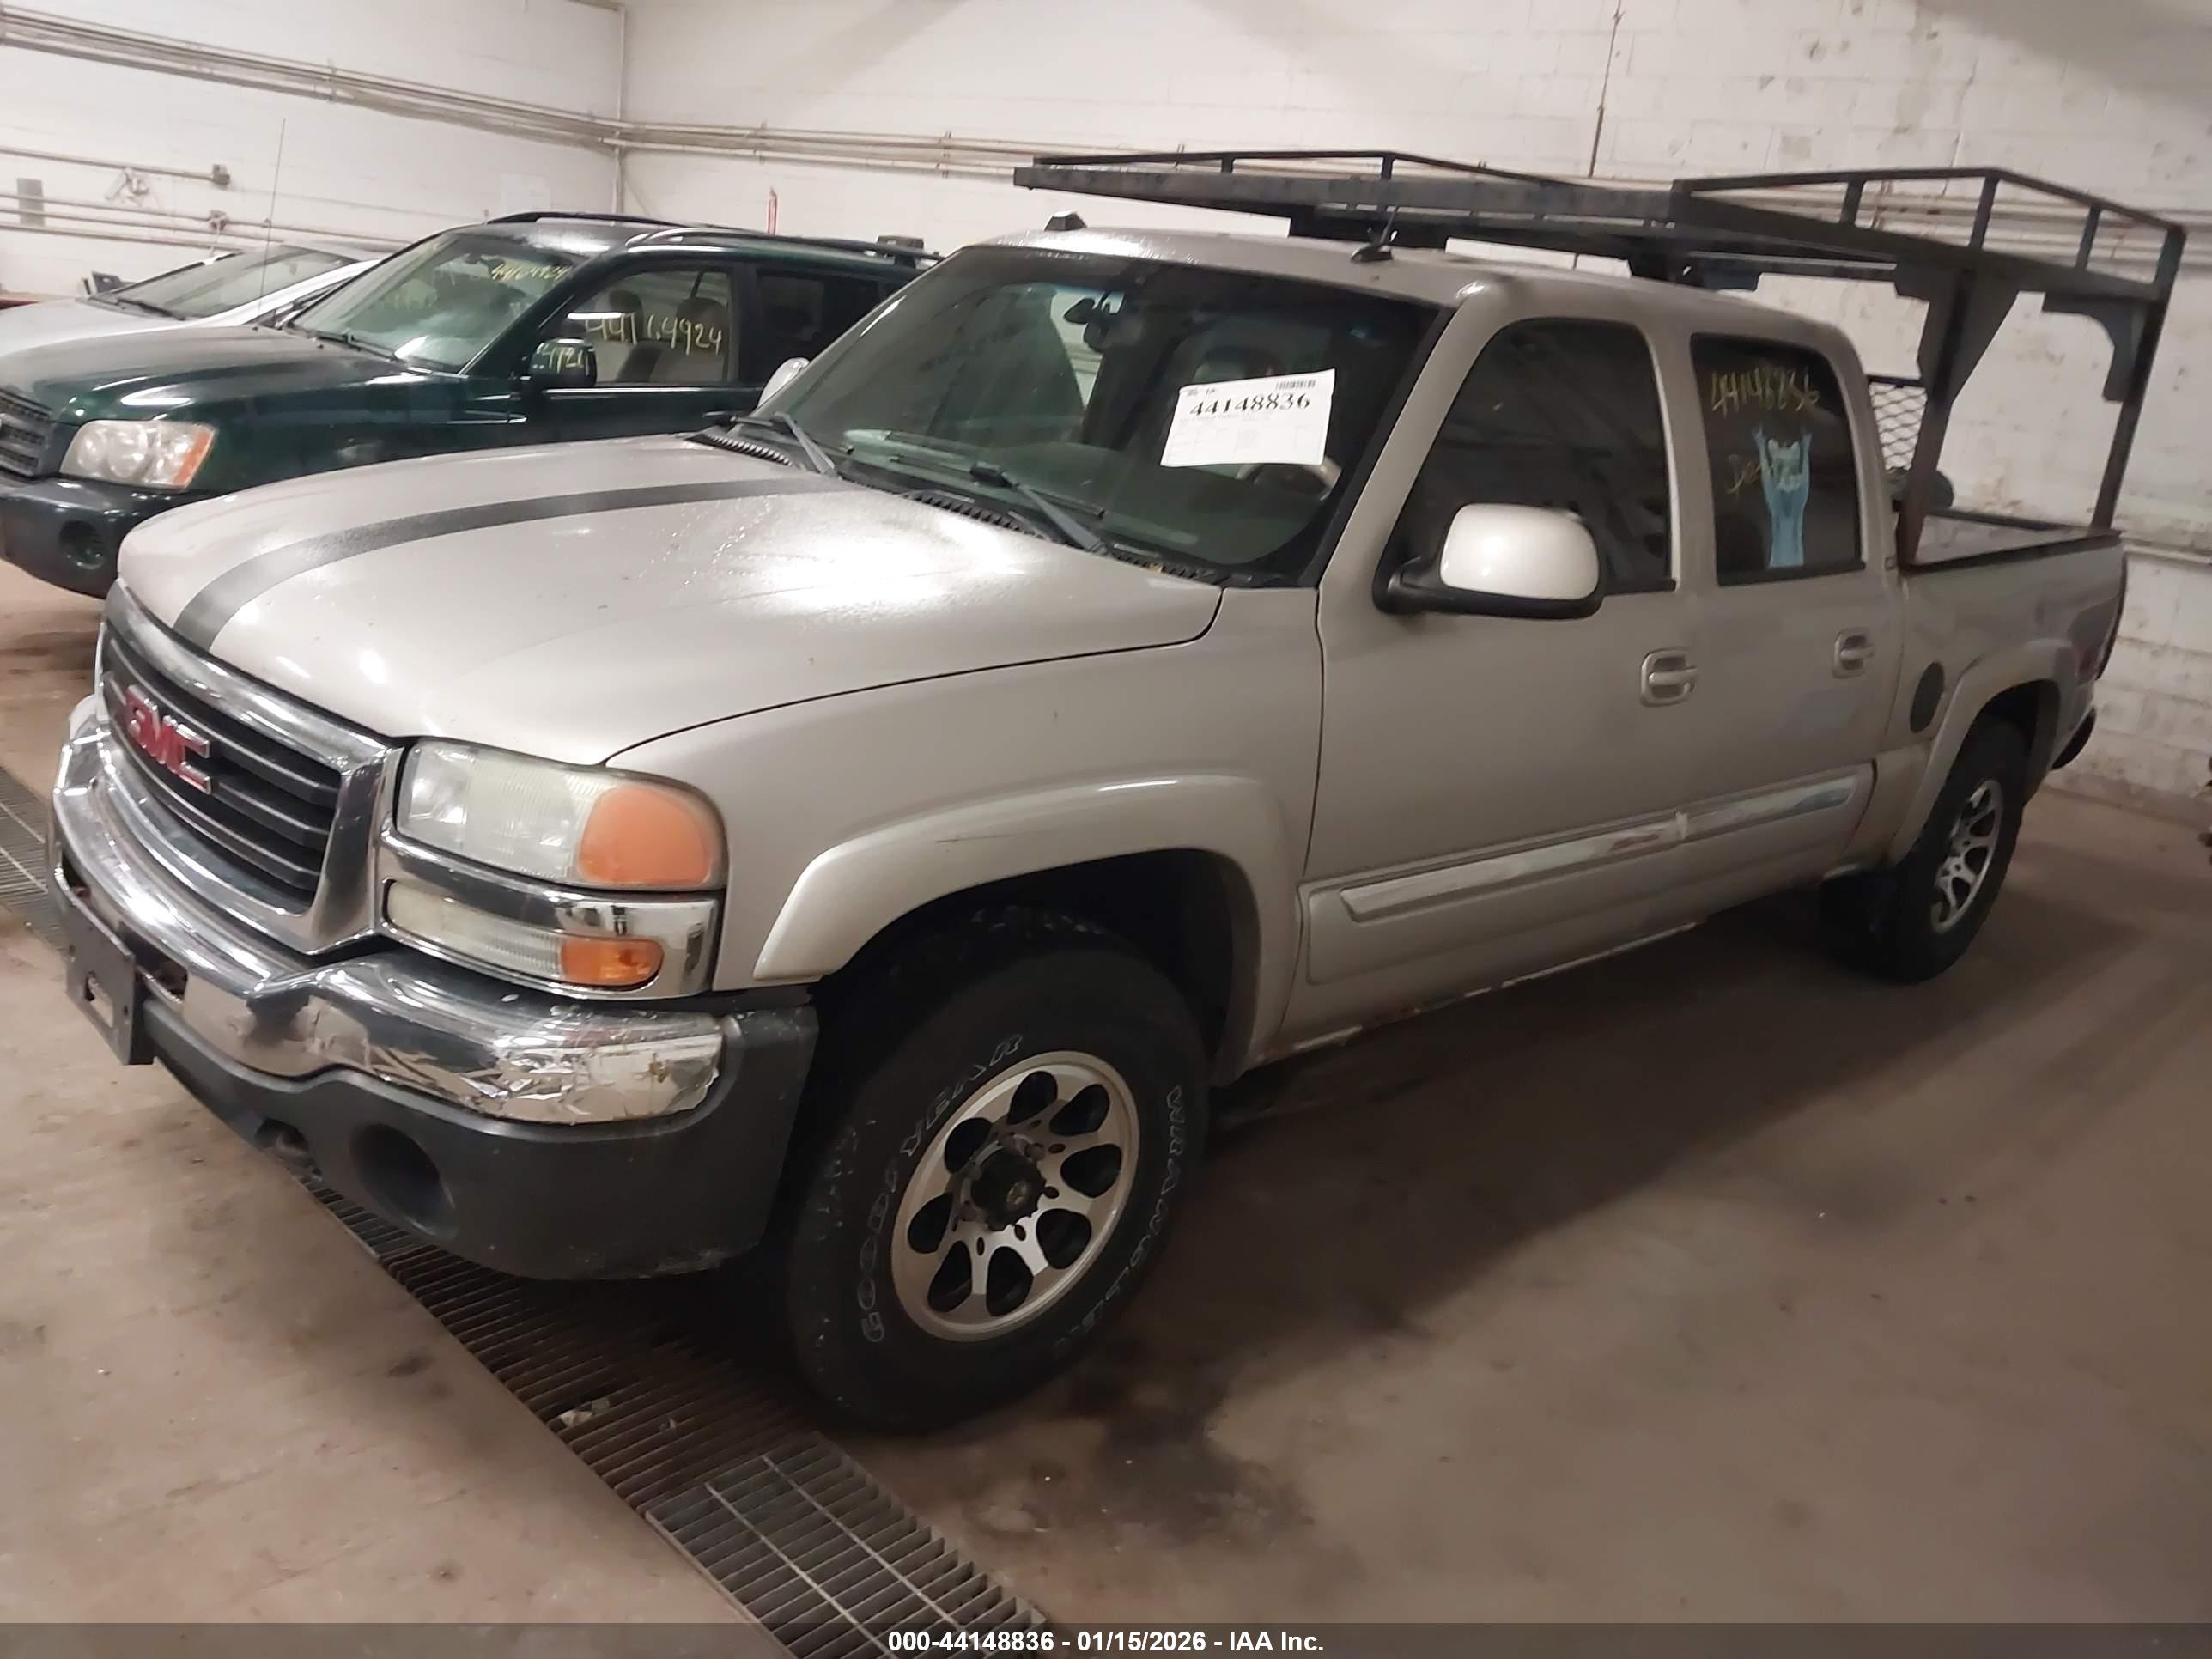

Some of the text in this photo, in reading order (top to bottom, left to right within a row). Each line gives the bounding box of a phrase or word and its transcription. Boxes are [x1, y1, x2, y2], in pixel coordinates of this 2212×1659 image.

[1189, 392, 1310, 416] 44148836
[125, 684, 211, 795] GMC
[858, 1035, 1023, 1342] GOODYEAR
